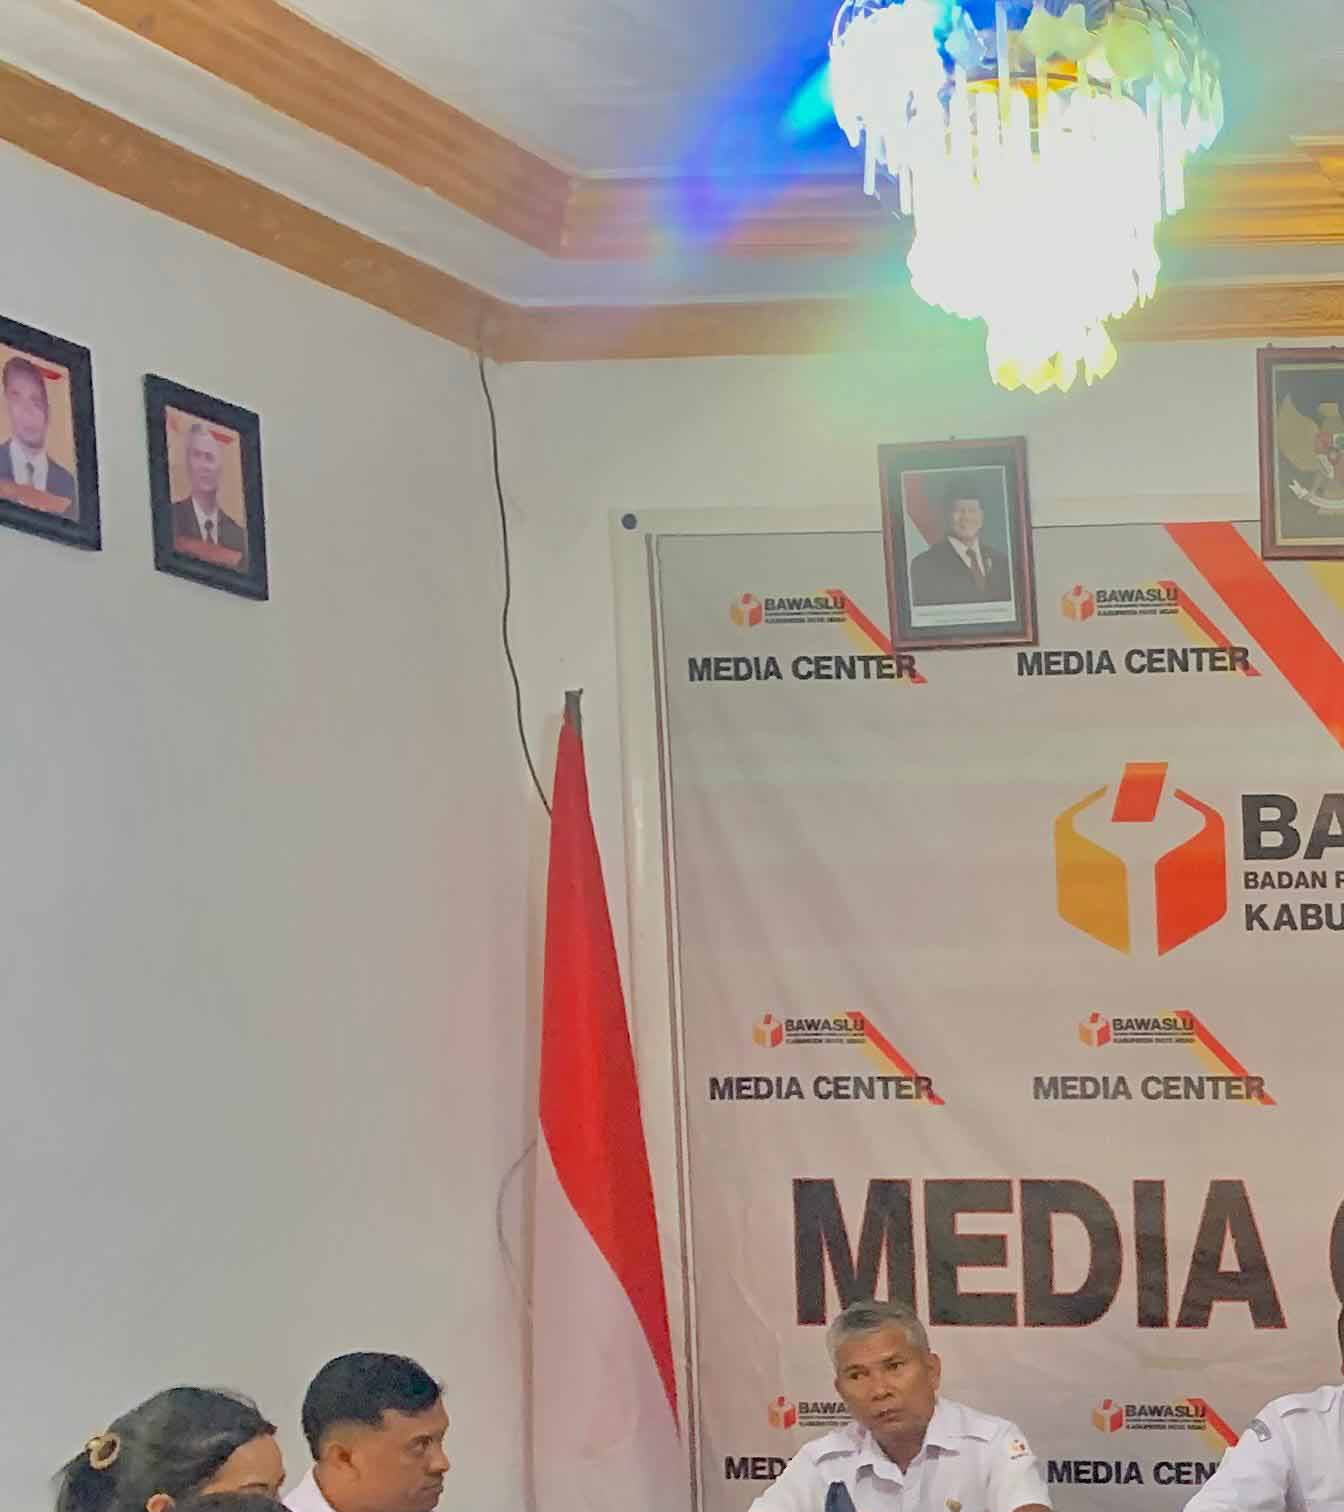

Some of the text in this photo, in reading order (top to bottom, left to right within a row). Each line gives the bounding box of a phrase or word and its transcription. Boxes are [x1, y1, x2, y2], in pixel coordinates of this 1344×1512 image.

[764, 596, 846, 611] BAWASLU
[1096, 588, 1179, 603] BAWASLU
[688, 653, 918, 682] MEDIA CENTER
[1017, 646, 1250, 676] MEDIA CENTER
[1243, 870, 1327, 890] BADAN
[784, 1019, 865, 1032] BAWASLU
[1112, 1018, 1194, 1031] BAWASLU
[708, 1076, 934, 1100] MEDIA CENTER
[1032, 1075, 1265, 1100] MEDIA CENTER
[792, 1178, 1288, 1329] MEDIA
[799, 1402, 847, 1414] BAWA
[1124, 1404, 1207, 1418] BAWASLU
[725, 1456, 792, 1479] MED
[1047, 1460, 1221, 1485] MEDIA CEN
